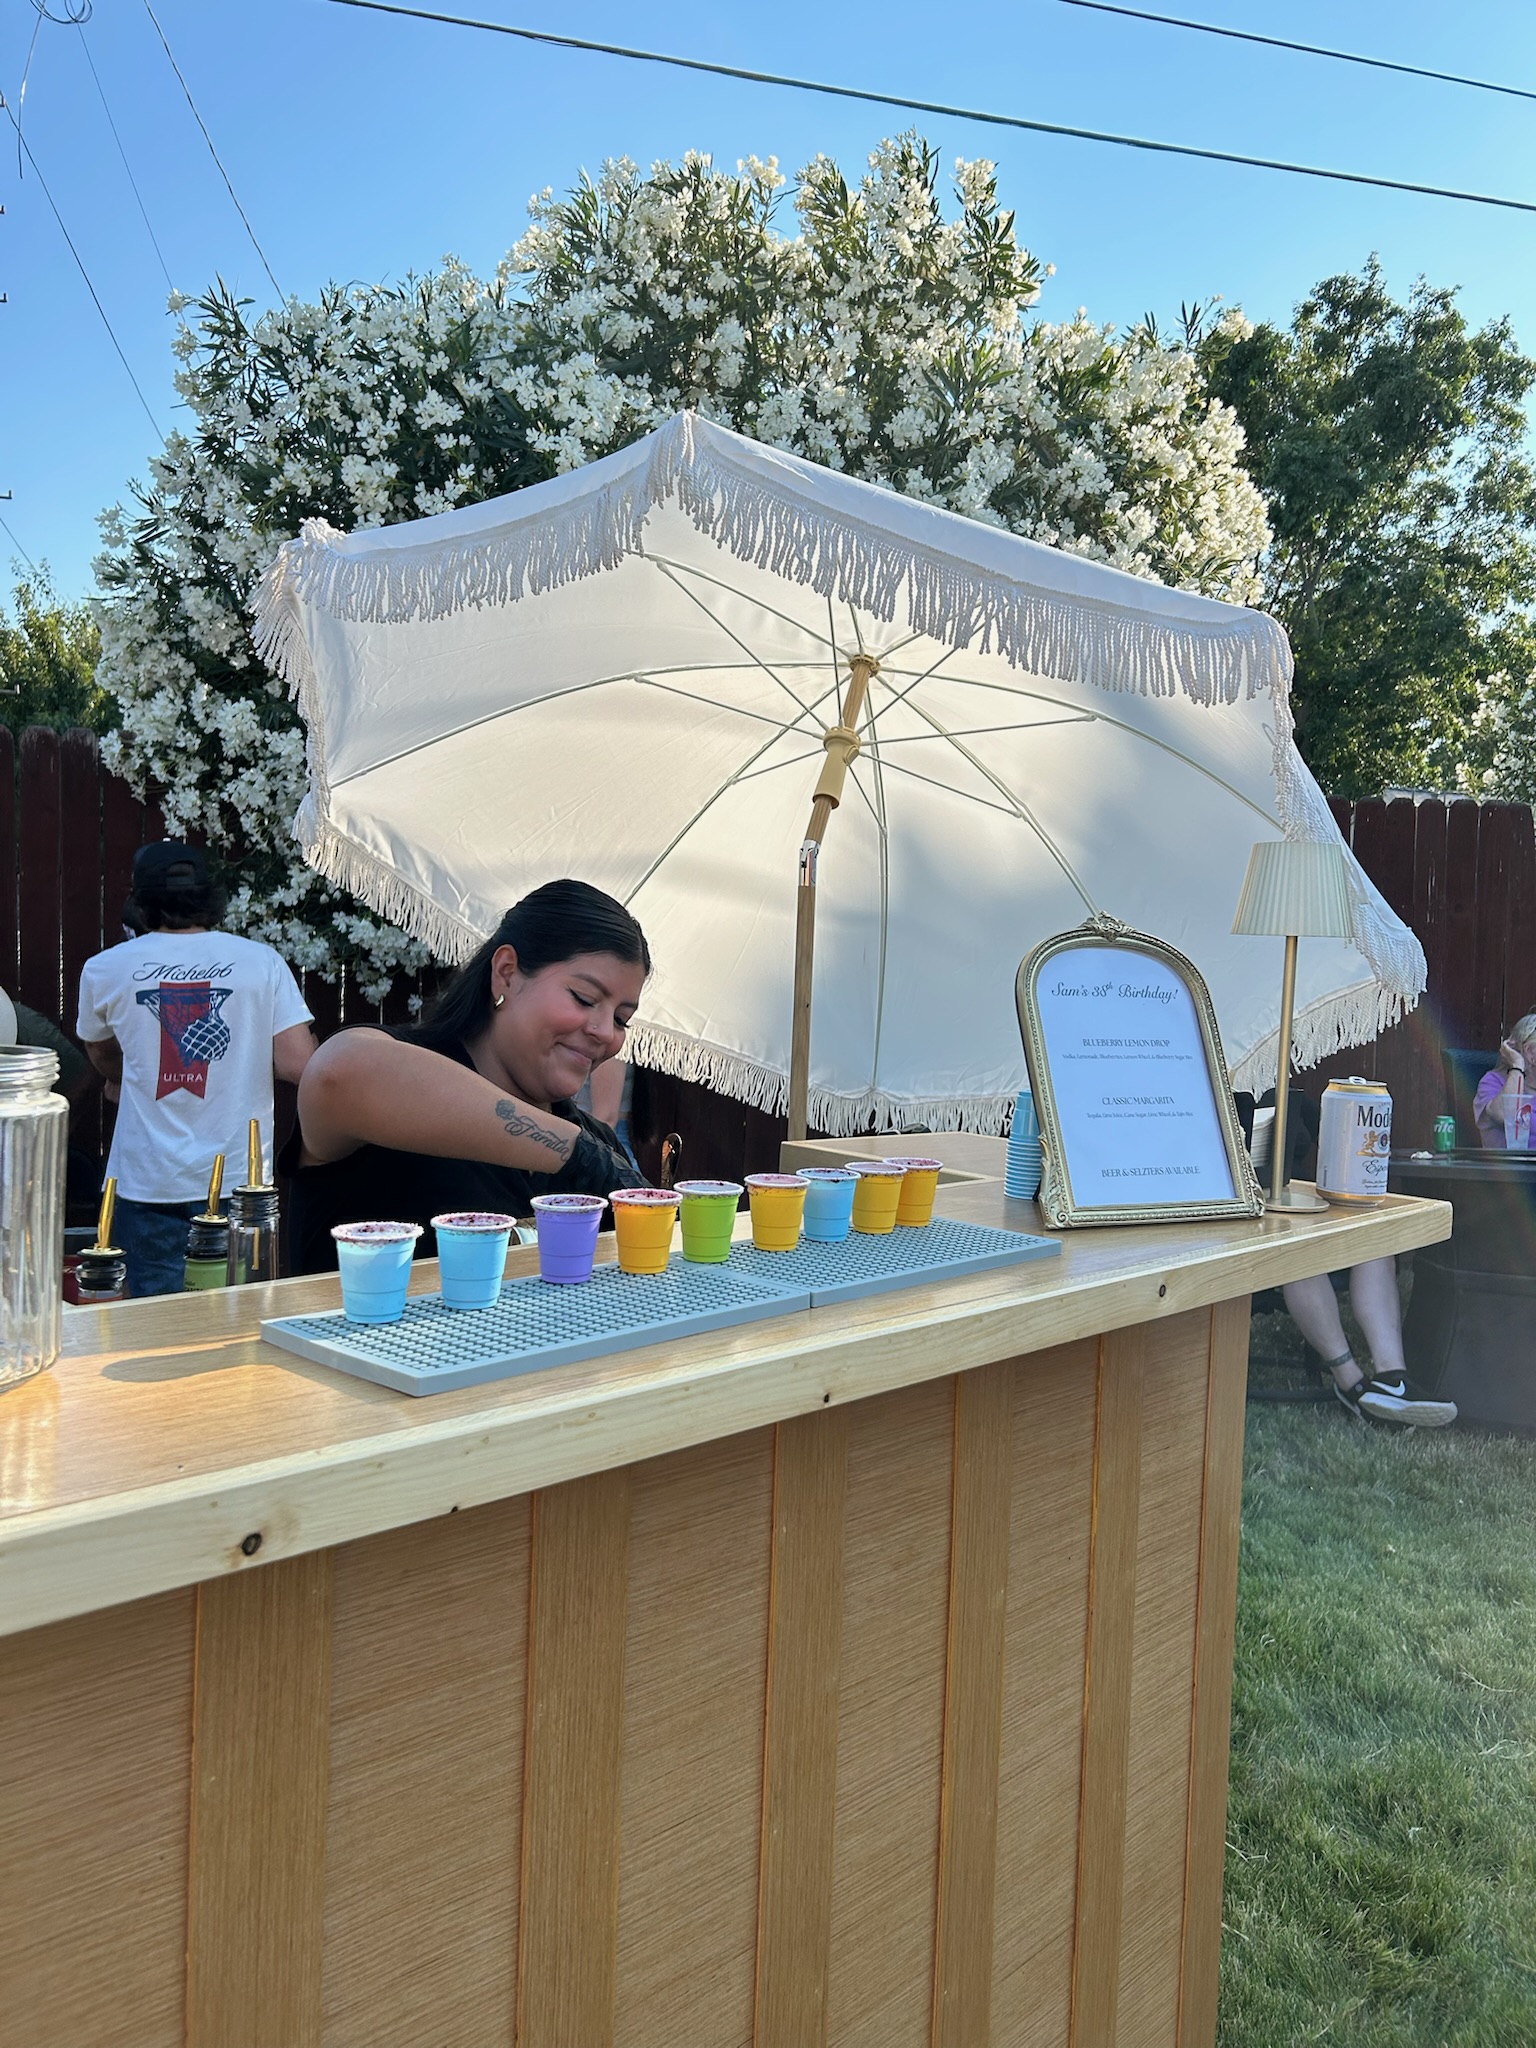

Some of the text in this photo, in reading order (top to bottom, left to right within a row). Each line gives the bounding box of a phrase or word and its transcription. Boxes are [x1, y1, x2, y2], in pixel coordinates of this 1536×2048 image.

[133, 962, 236, 982] Michelob
[1051, 982, 1089, 997] Sam's
[1118, 984, 1179, 1005] Birthday!
[1082, 1038, 1171, 1048] BLUEBERRY LEMON DROP
[163, 1073, 203, 1083] ULTRA
[1101, 1096, 1175, 1106] CLASSIC MARGARITA
[1101, 1165, 1200, 1178] BEER & SELZTERS AVAILABLE
